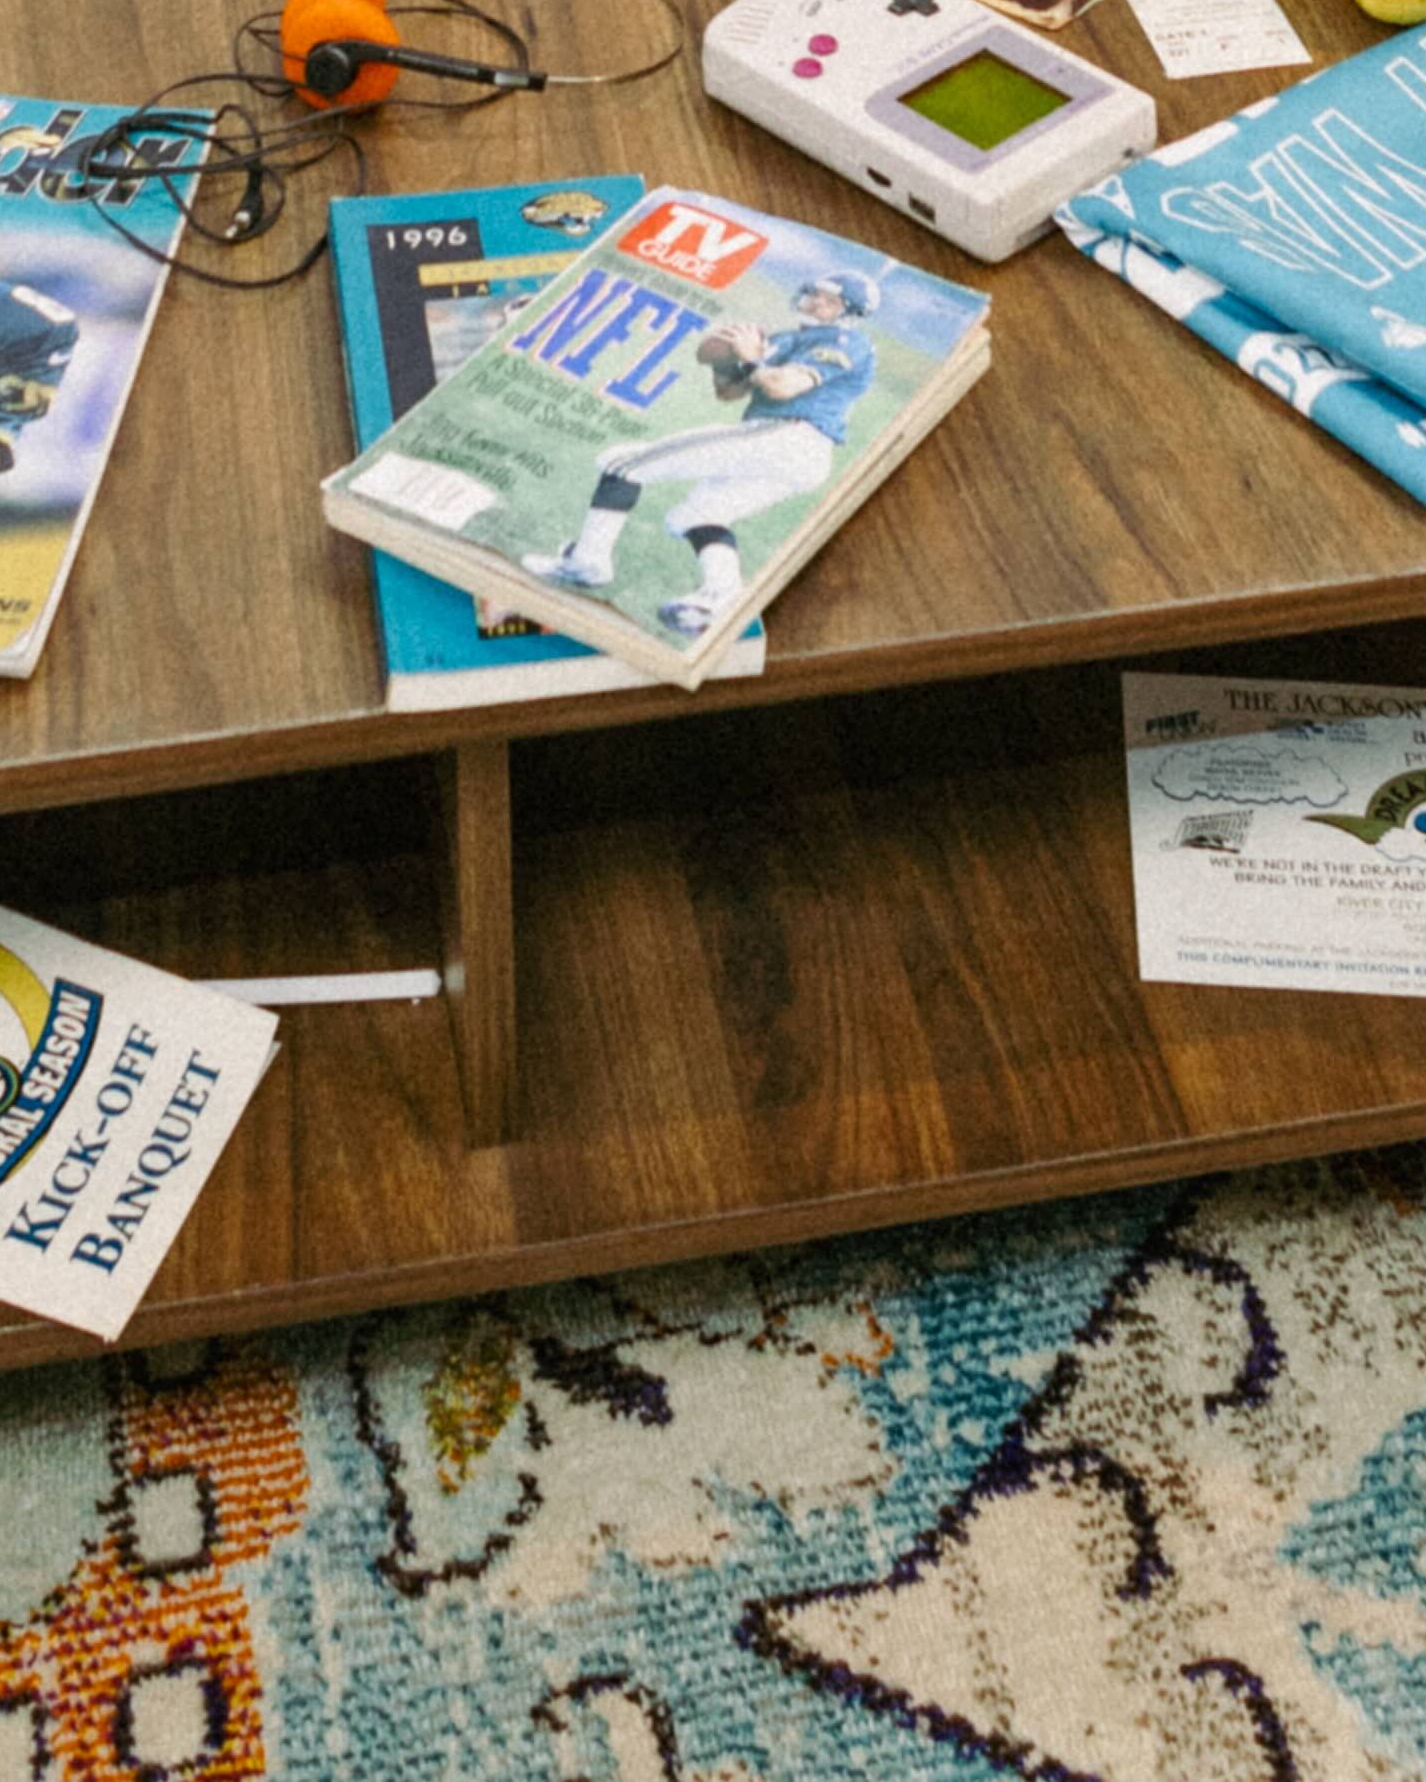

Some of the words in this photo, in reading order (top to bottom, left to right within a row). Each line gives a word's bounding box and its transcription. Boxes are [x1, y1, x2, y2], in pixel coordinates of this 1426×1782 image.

[385, 226, 469, 251] 1996
[654, 205, 761, 263] TV
[637, 238, 719, 281] GUIDE
[506, 267, 710, 411] NFL
[1224, 689, 1278, 714] THE
[1292, 875, 1322, 889] THE
[1324, 862, 1354, 875] THE
[27, 990, 92, 1124] SEASON
